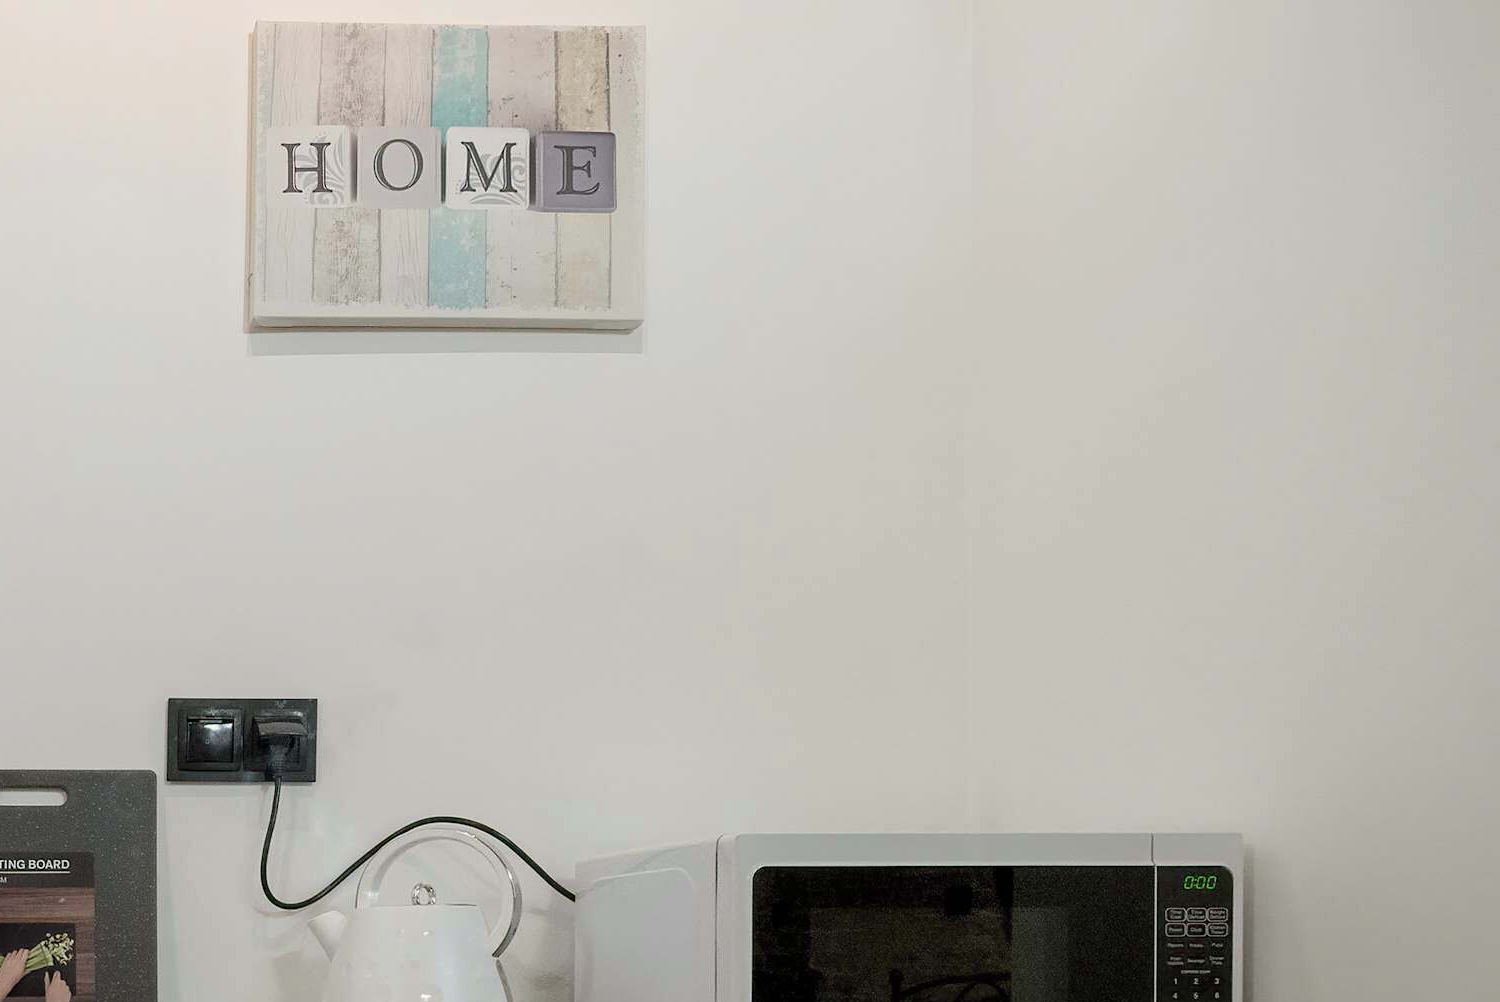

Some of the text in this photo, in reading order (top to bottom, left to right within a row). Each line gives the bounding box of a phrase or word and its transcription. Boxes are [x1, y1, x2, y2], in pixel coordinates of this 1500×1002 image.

[281, 138, 601, 195] HOME
[28, 859, 70, 870] BOARD
[1184, 875, 1217, 890] 0:00
[1193, 977, 1199, 985] 2
